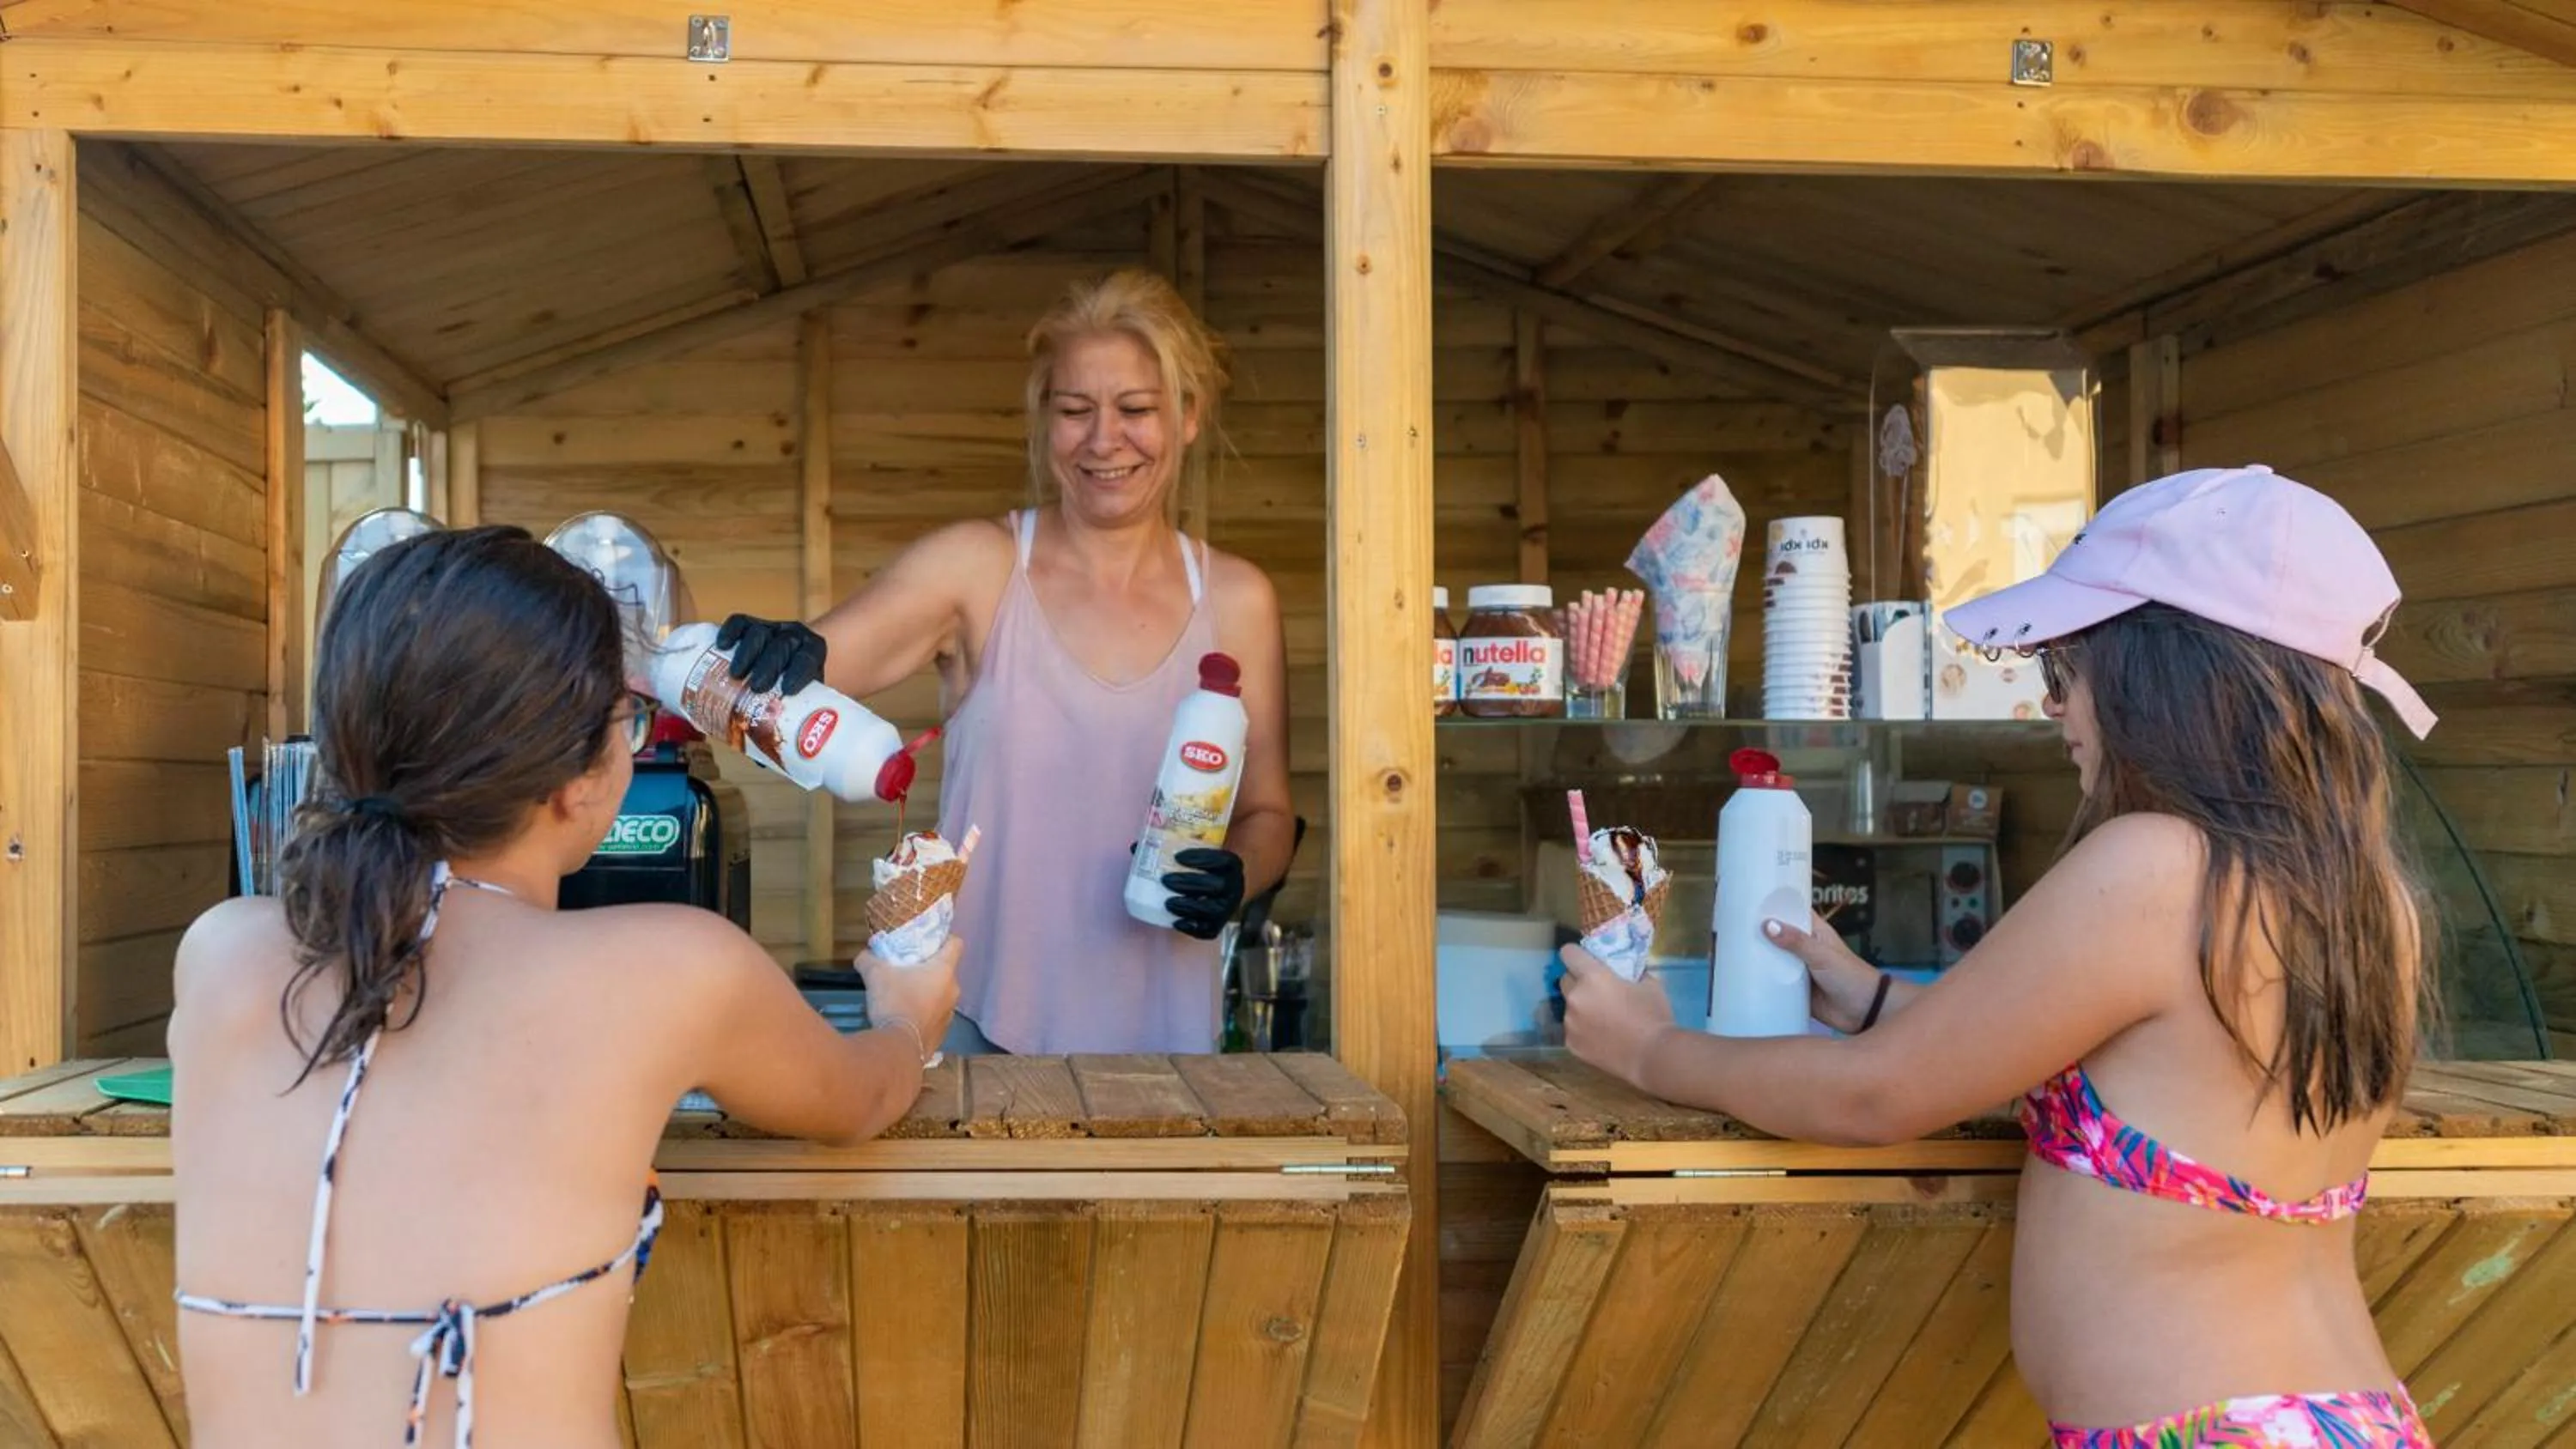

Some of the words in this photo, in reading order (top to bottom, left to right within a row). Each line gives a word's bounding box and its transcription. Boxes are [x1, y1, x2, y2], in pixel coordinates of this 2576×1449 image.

[1463, 640, 1545, 664] nutella
[803, 711, 834, 752] SKO
[1184, 746, 1222, 765] SKO
[1812, 884, 1869, 905] oritos
